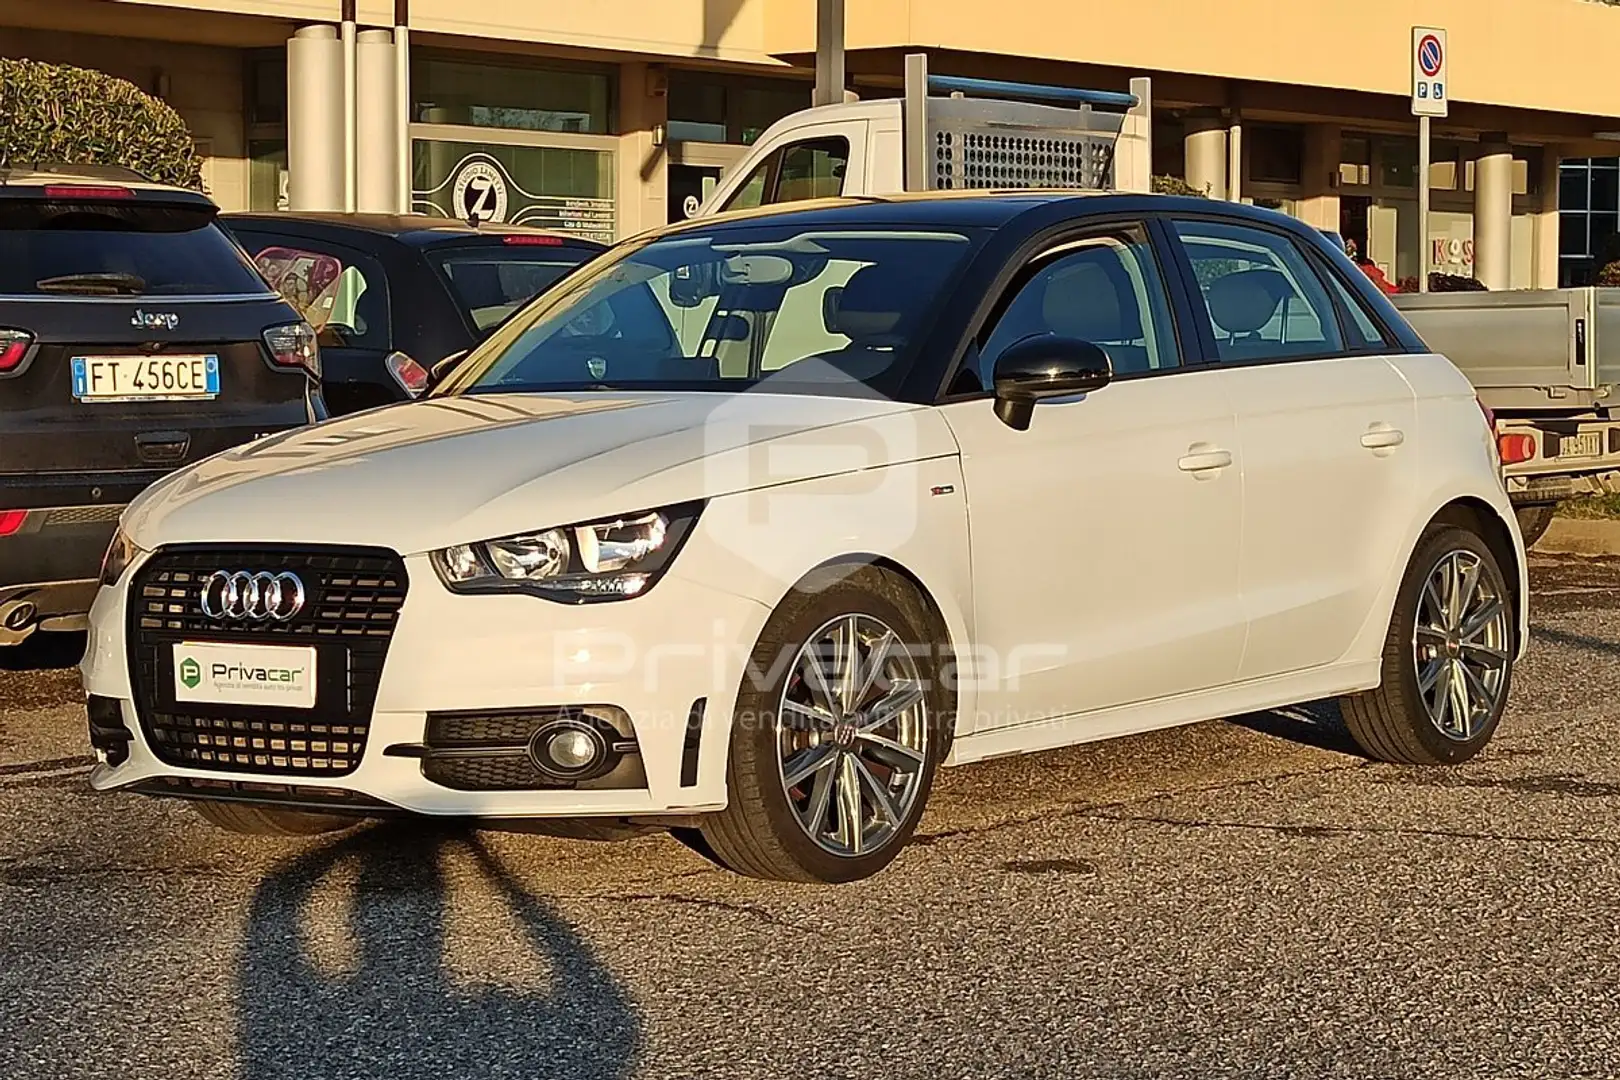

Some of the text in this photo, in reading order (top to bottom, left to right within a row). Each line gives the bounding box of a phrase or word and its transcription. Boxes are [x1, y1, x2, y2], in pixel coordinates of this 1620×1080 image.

[131, 309, 179, 330] Jeep
[91, 361, 204, 392] FT 456CE
[212, 661, 302, 683] Privacar
